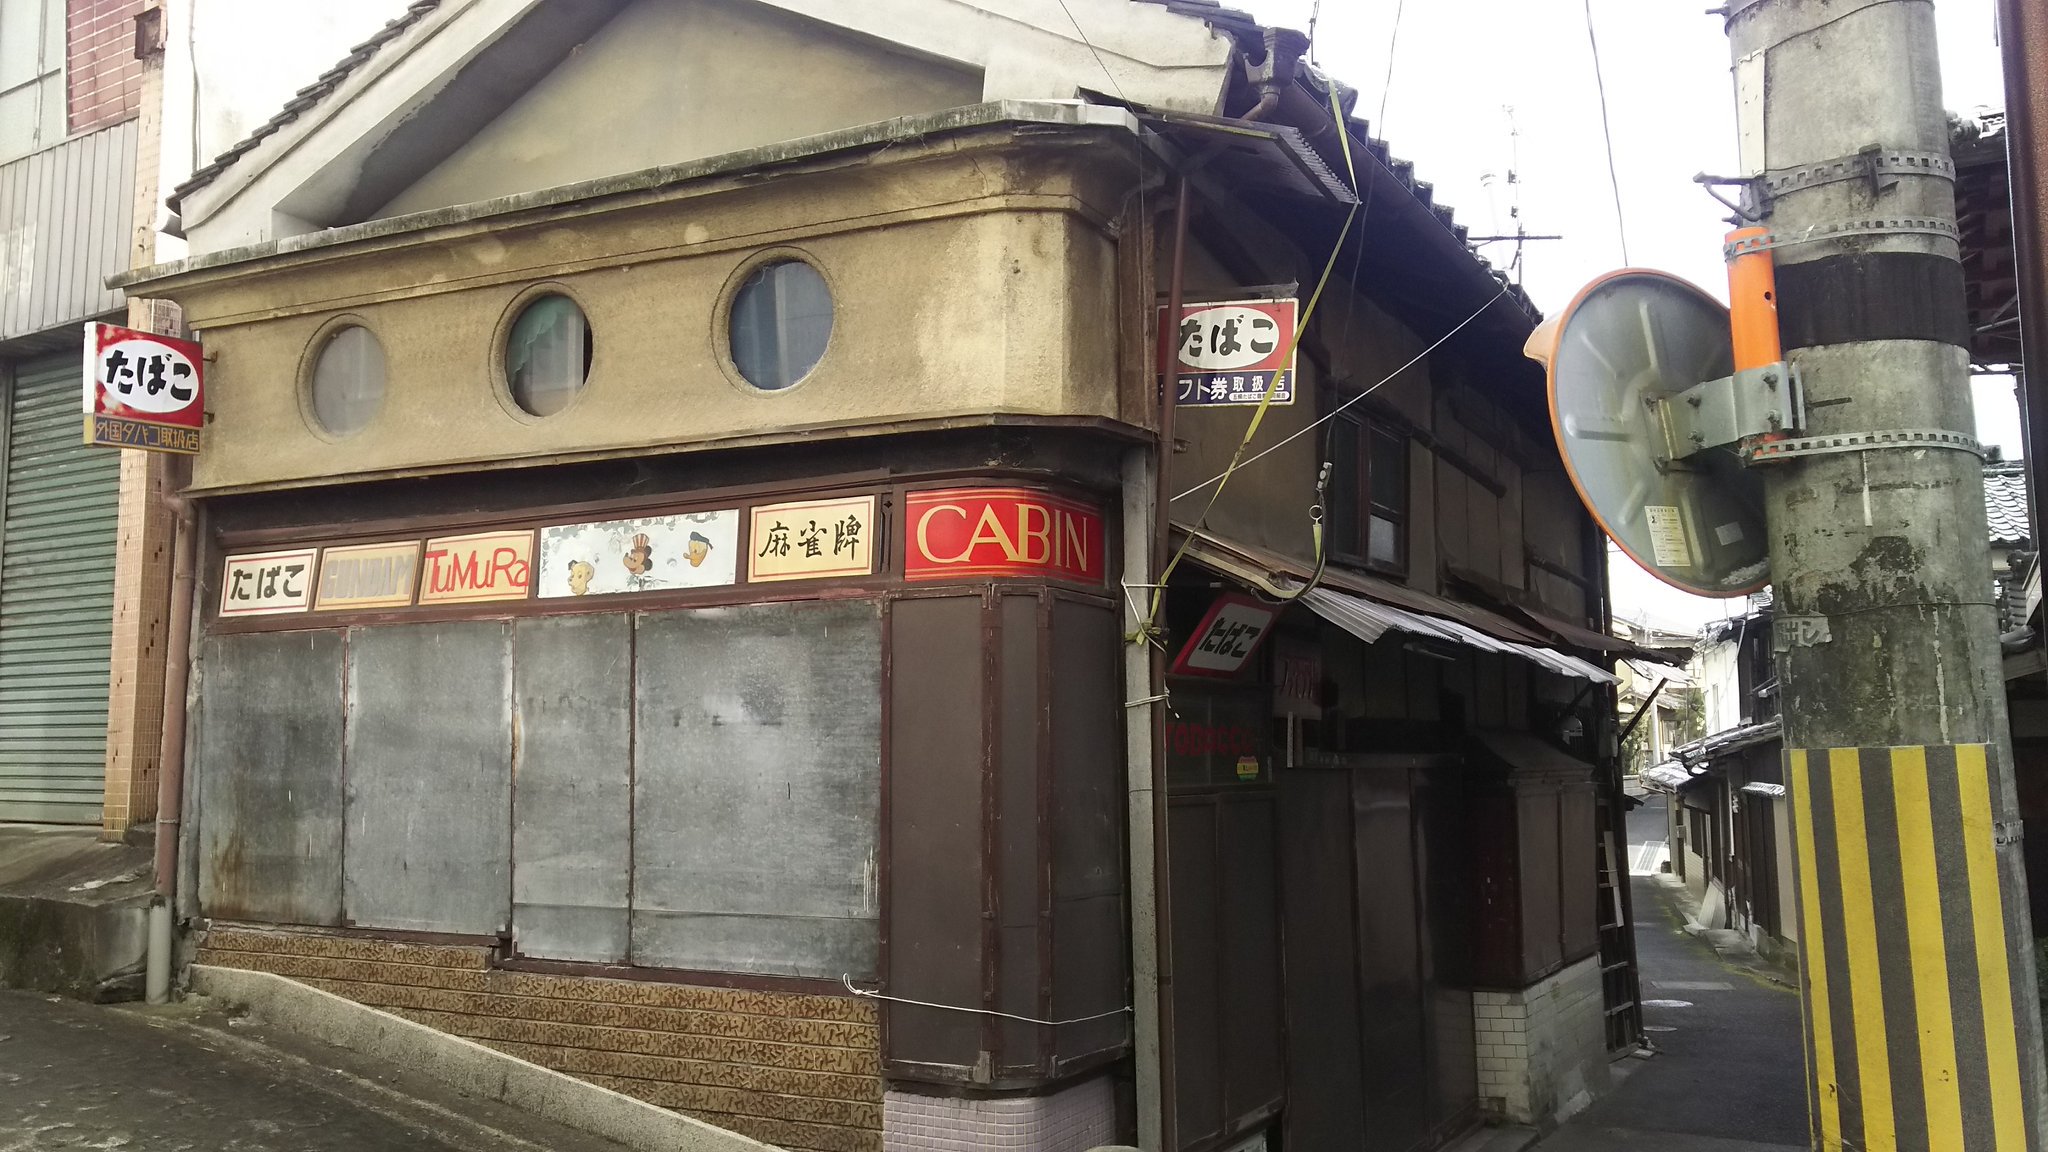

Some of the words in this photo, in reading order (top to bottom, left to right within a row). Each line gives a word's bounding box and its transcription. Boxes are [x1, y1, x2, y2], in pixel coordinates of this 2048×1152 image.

[1179, 314, 1273, 357] たばこ
[106, 349, 192, 401] たばこ
[96, 421, 199, 450] 外国タバコ取扱店
[759, 514, 862, 562] 麻雀牌
[916, 503, 1088, 572] CABIN
[229, 564, 305, 601] たばこ
[321, 554, 413, 599] GUNDAM
[1198, 617, 1261, 659] たばこ
